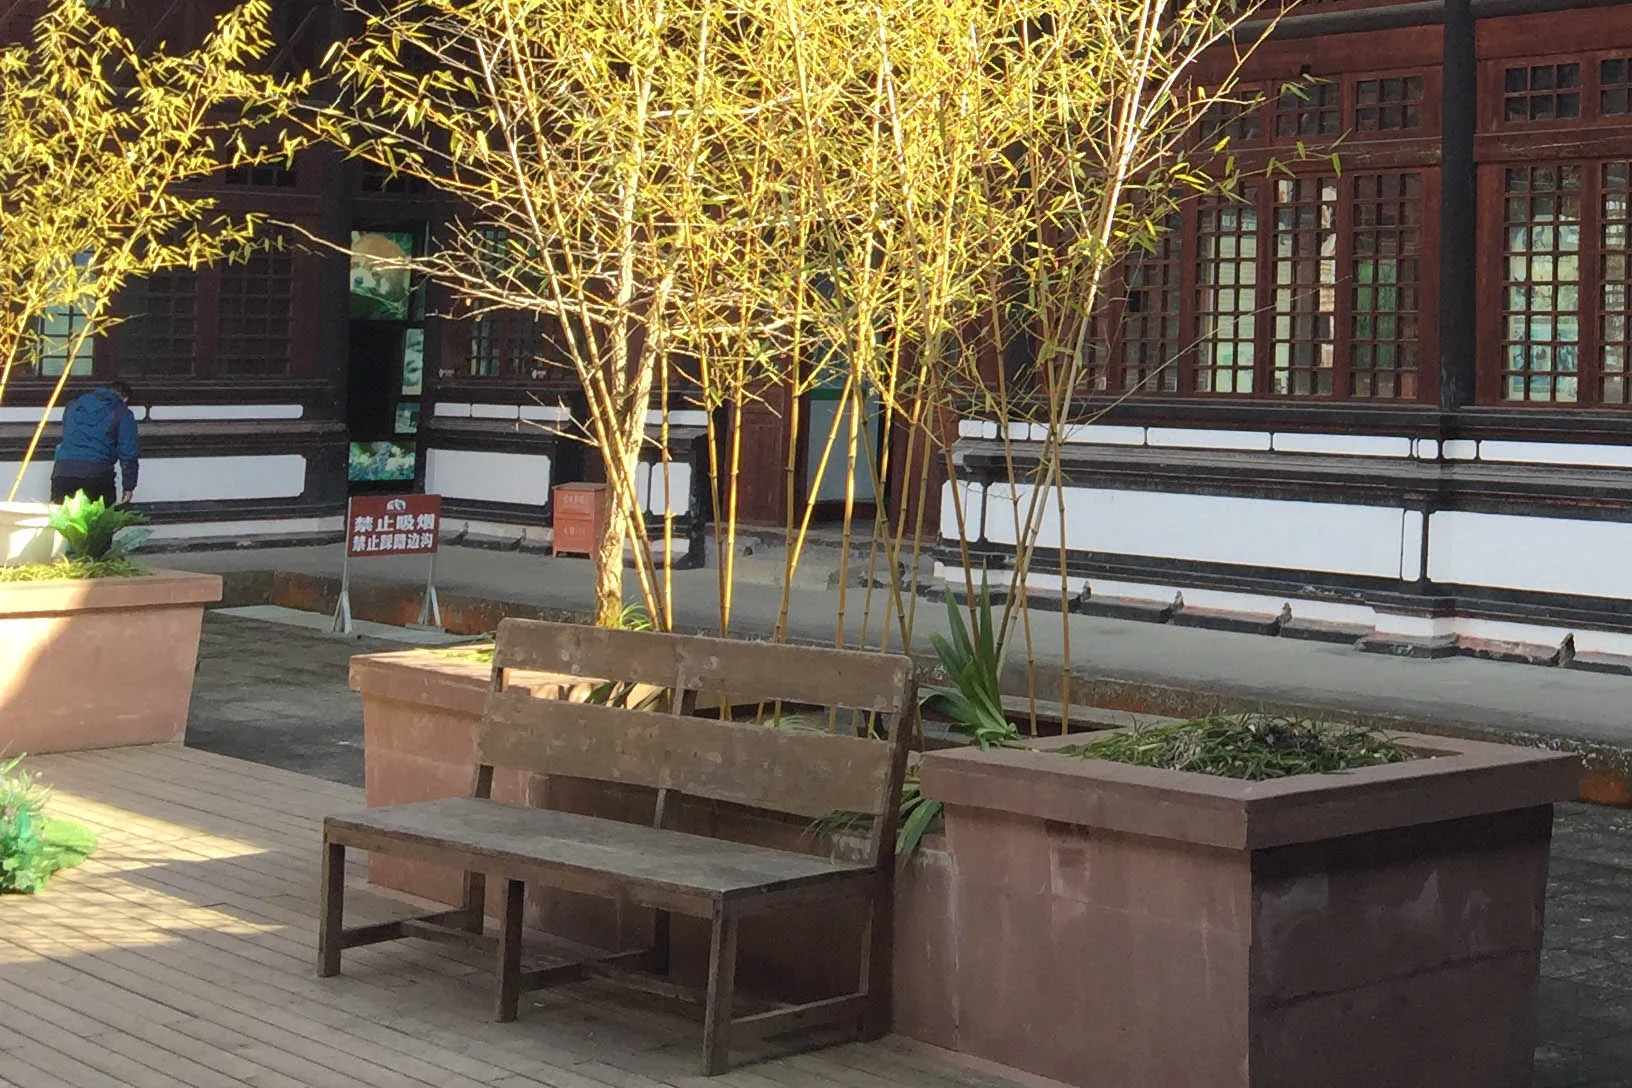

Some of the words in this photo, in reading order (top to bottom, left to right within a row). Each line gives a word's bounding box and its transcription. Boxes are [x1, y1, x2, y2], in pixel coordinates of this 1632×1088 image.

[354, 513, 435, 533] 禁止吸烟
[352, 534, 434, 552] 禁止踩踏边沟
